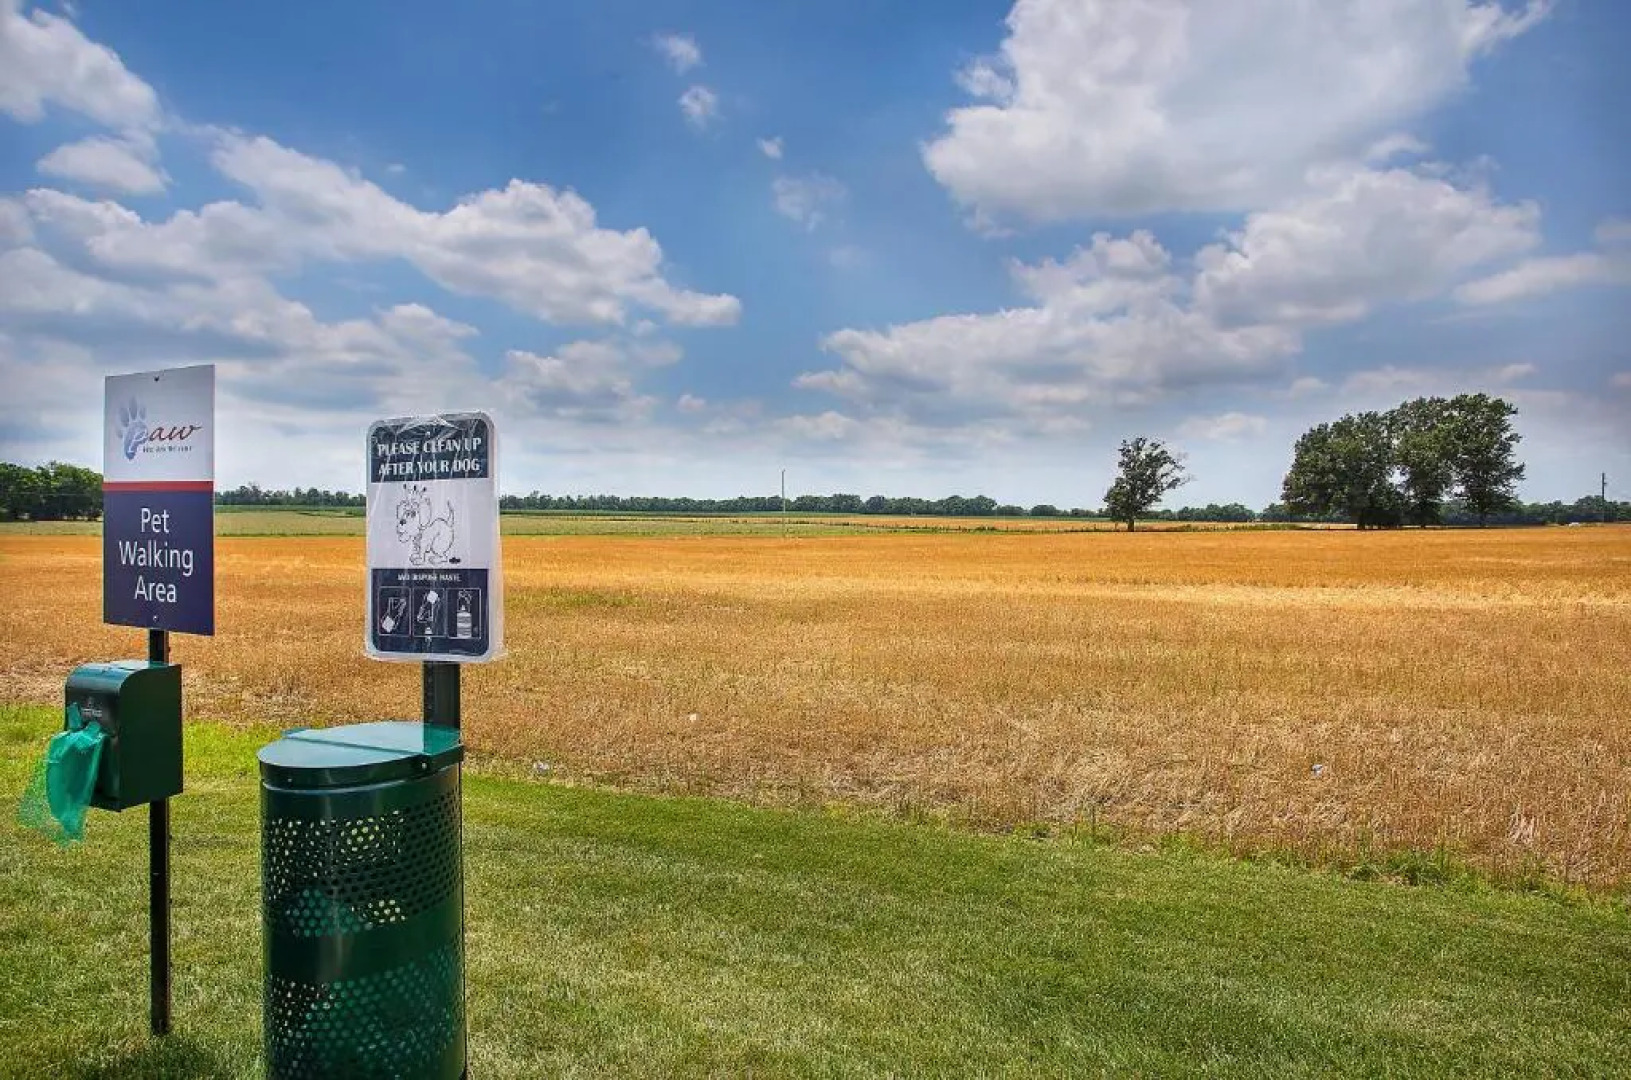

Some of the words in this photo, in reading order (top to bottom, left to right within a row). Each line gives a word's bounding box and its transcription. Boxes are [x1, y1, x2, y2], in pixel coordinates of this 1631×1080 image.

[377, 440, 420, 456] PLEASE
[423, 437, 461, 453] CLEAN
[464, 437, 482, 451] UP
[379, 461, 413, 476] AFTER
[417, 459, 450, 473] YOUR
[452, 458, 480, 472] DOG
[141, 508, 170, 533] Pet
[119, 540, 194, 576] Walking
[134, 575, 177, 603] Area
